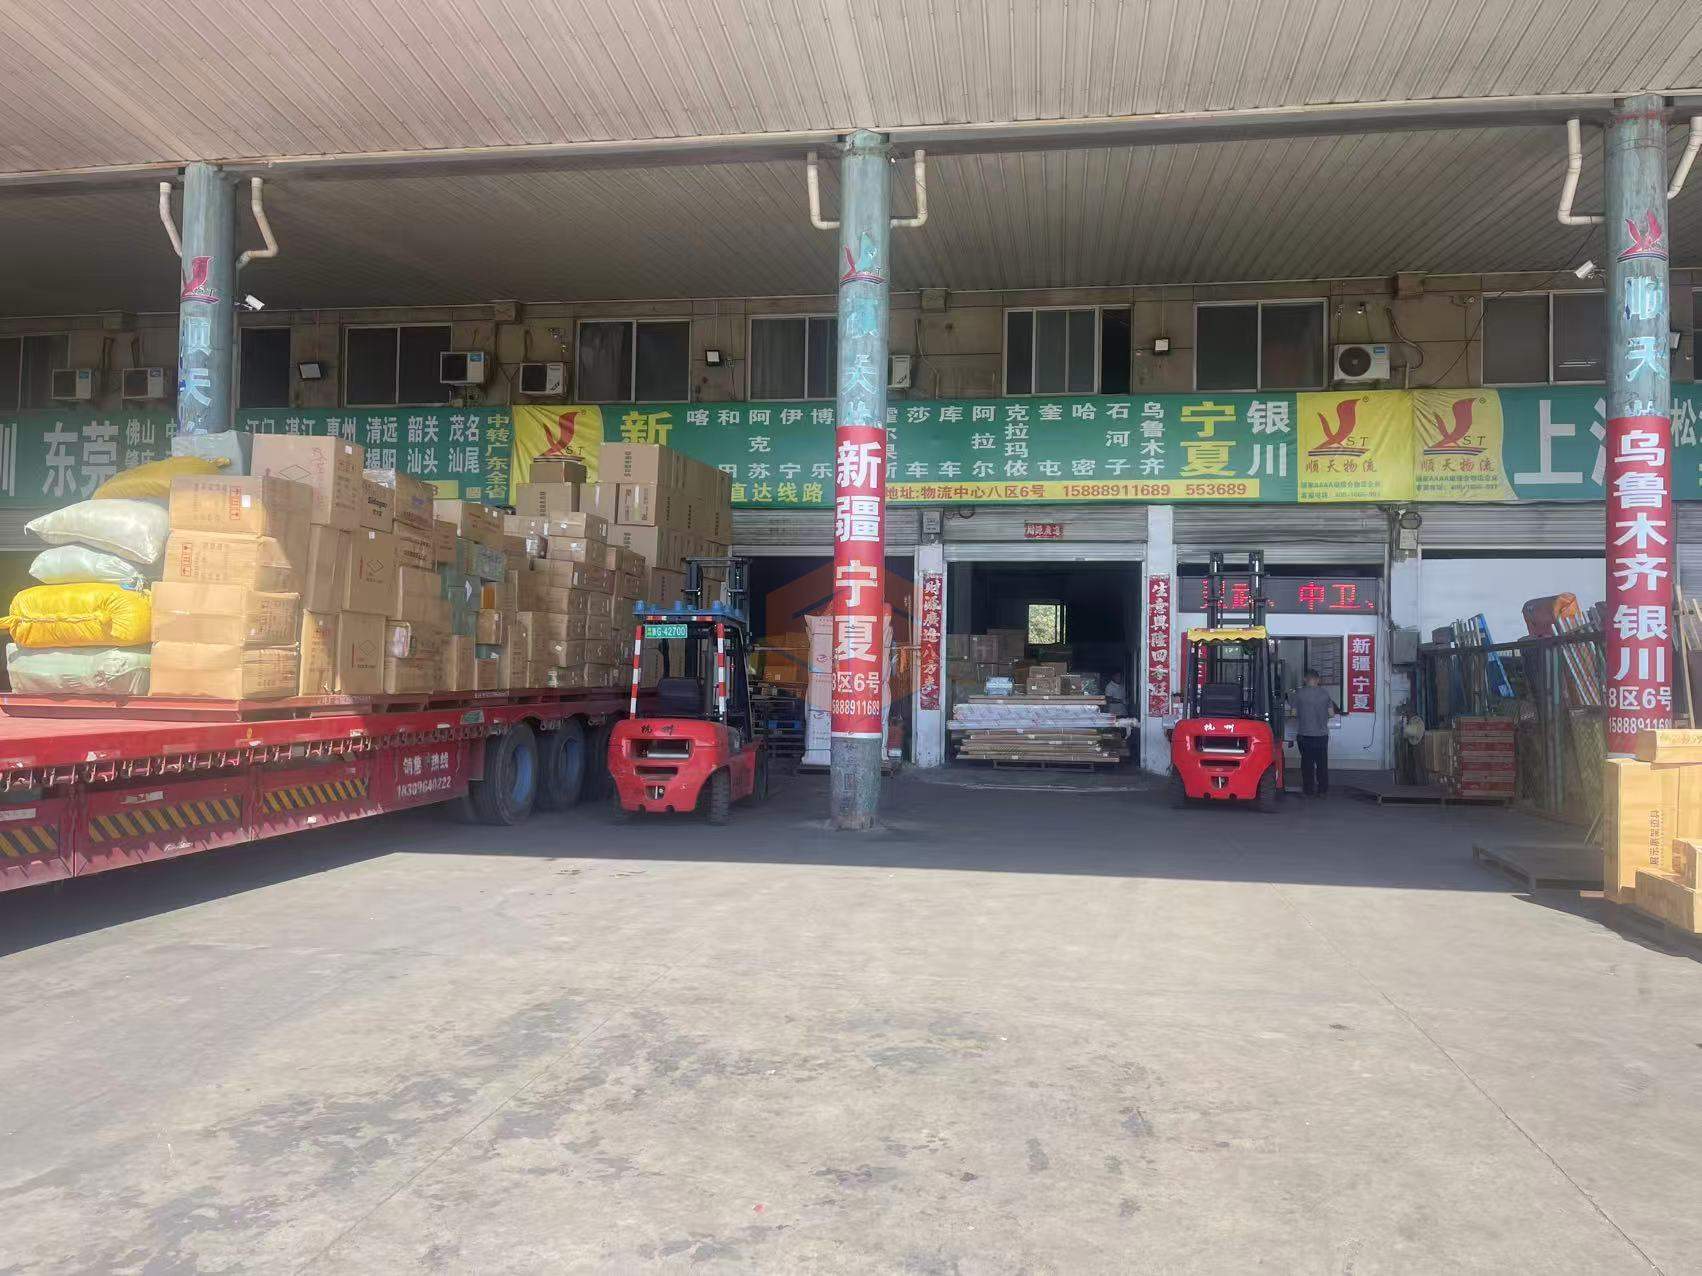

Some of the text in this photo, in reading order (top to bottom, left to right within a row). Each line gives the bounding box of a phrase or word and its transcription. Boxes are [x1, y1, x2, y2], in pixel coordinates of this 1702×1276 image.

[126, 418, 155, 446] 佛山
[166, 418, 178, 438] 中
[366, 416, 398, 444] 清远
[408, 415, 439, 443] 韶关
[448, 414, 480, 442] 茂名
[621, 411, 672, 447] 新
[687, 409, 709, 426] 喀
[748, 410, 771, 479] 阿克苏
[780, 408, 804, 479] 伊宁
[811, 408, 834, 479] 博乐
[905, 407, 931, 478] 莎车
[939, 406, 963, 477] 库车
[972, 406, 996, 477] 阿拉尔
[1004, 404, 1029, 477] 克拉玛依
[1037, 404, 1063, 476] 奎屯
[1072, 403, 1096, 476] 哈密
[1105, 403, 1131, 475] 石河子
[1139, 402, 1166, 475] 乌鲁木齐
[1179, 401, 1236, 476] 宁夏
[1247, 400, 1291, 476] 银川
[1513, 399, 1606, 487] 上
[1671, 398, 1702, 447] 松
[42, 420, 119, 498] 东莞
[407, 448, 439, 474] 汕头
[447, 447, 480, 474] 汕尾
[731, 481, 823, 503] 直达线路
[1063, 484, 1170, 497] 15888911689
[1186, 483, 1248, 496] 553689
[1306, 459, 1377, 473] 顺天物流
[1422, 457, 1496, 473] 顺天物流
[835, 441, 882, 664] 新疆宁夏
[1613, 429, 1668, 683] 乌鲁木齐银川
[1352, 637, 1371, 710] 新疆宁夏
